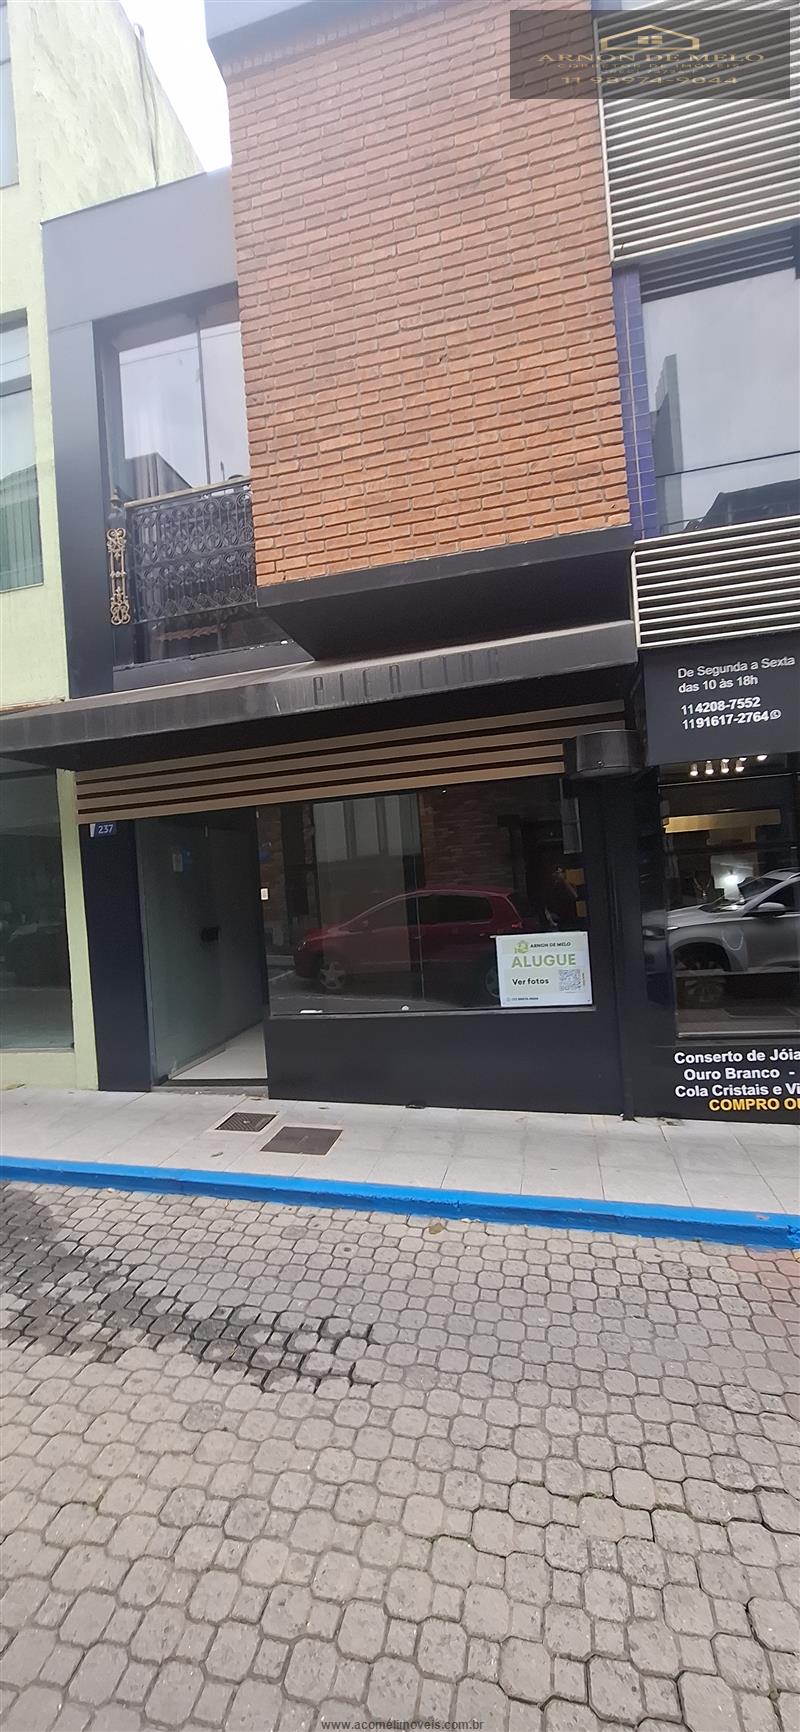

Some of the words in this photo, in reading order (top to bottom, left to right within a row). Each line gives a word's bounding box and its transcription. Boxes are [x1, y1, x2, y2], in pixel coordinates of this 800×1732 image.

[677, 668, 695, 679] De
[697, 662, 748, 677] Segunda
[750, 660, 759, 670] a
[761, 656, 796, 669] Sexta
[678, 683, 700, 693] das
[702, 679, 717, 690] 10
[719, 678, 734, 689] às
[736, 674, 759, 687] 18h
[98, 823, 114, 834] 237
[512, 954, 576, 968] ALUGUE
[674, 1051, 743, 1064] Conserto
[746, 1049, 766, 1062] de
[683, 1068, 721, 1081] Ouro
[725, 1067, 780, 1080] Branco
[675, 1085, 709, 1097] Cola
[711, 1083, 770, 1096] Cristais
[772, 1085, 783, 1095] e
[708, 1097, 780, 1111] COMPRO
